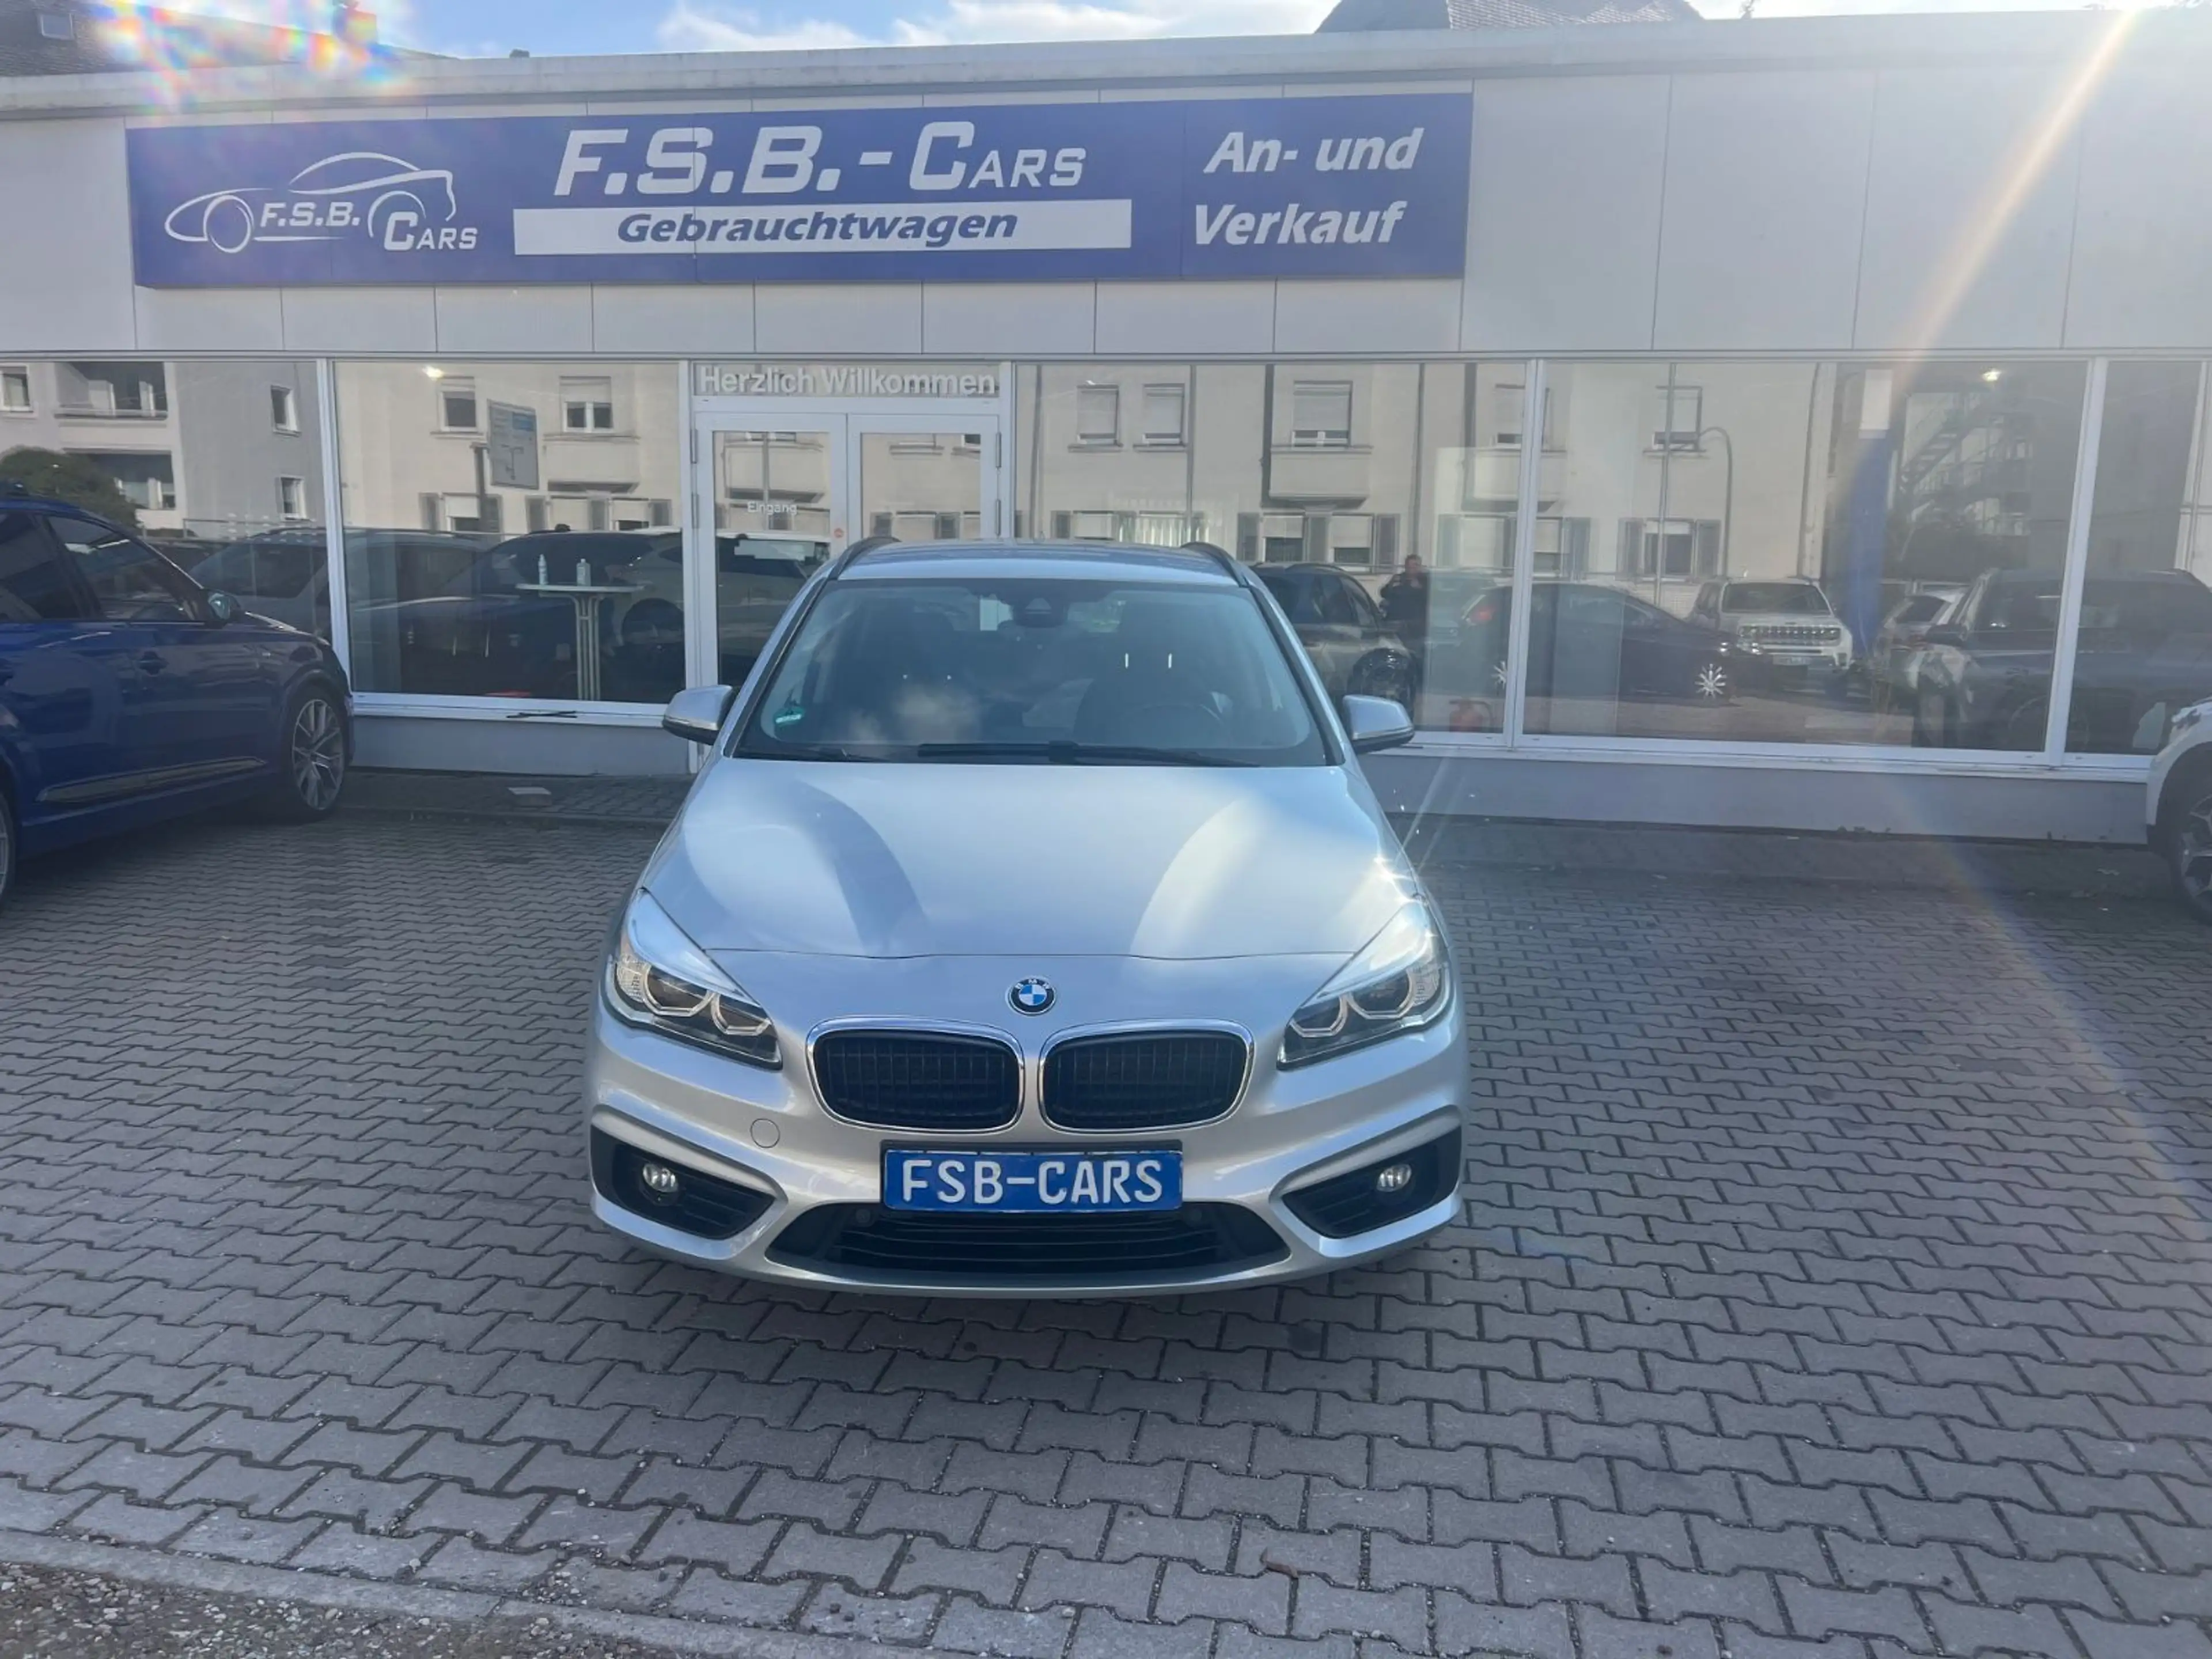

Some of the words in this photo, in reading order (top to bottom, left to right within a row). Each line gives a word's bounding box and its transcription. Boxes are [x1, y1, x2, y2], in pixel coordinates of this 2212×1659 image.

[1203, 131, 1299, 173] An-
[1315, 127, 1425, 171] und
[259, 202, 361, 228] F.S.B.
[618, 210, 1017, 248] Gebrauchtwagen
[1195, 200, 1408, 245] Verkauf
[699, 366, 816, 395] Herzlich
[821, 367, 995, 396] Willkommen
[748, 499, 798, 516] Eingang
[902, 1159, 1162, 1205] FSB-CARS
